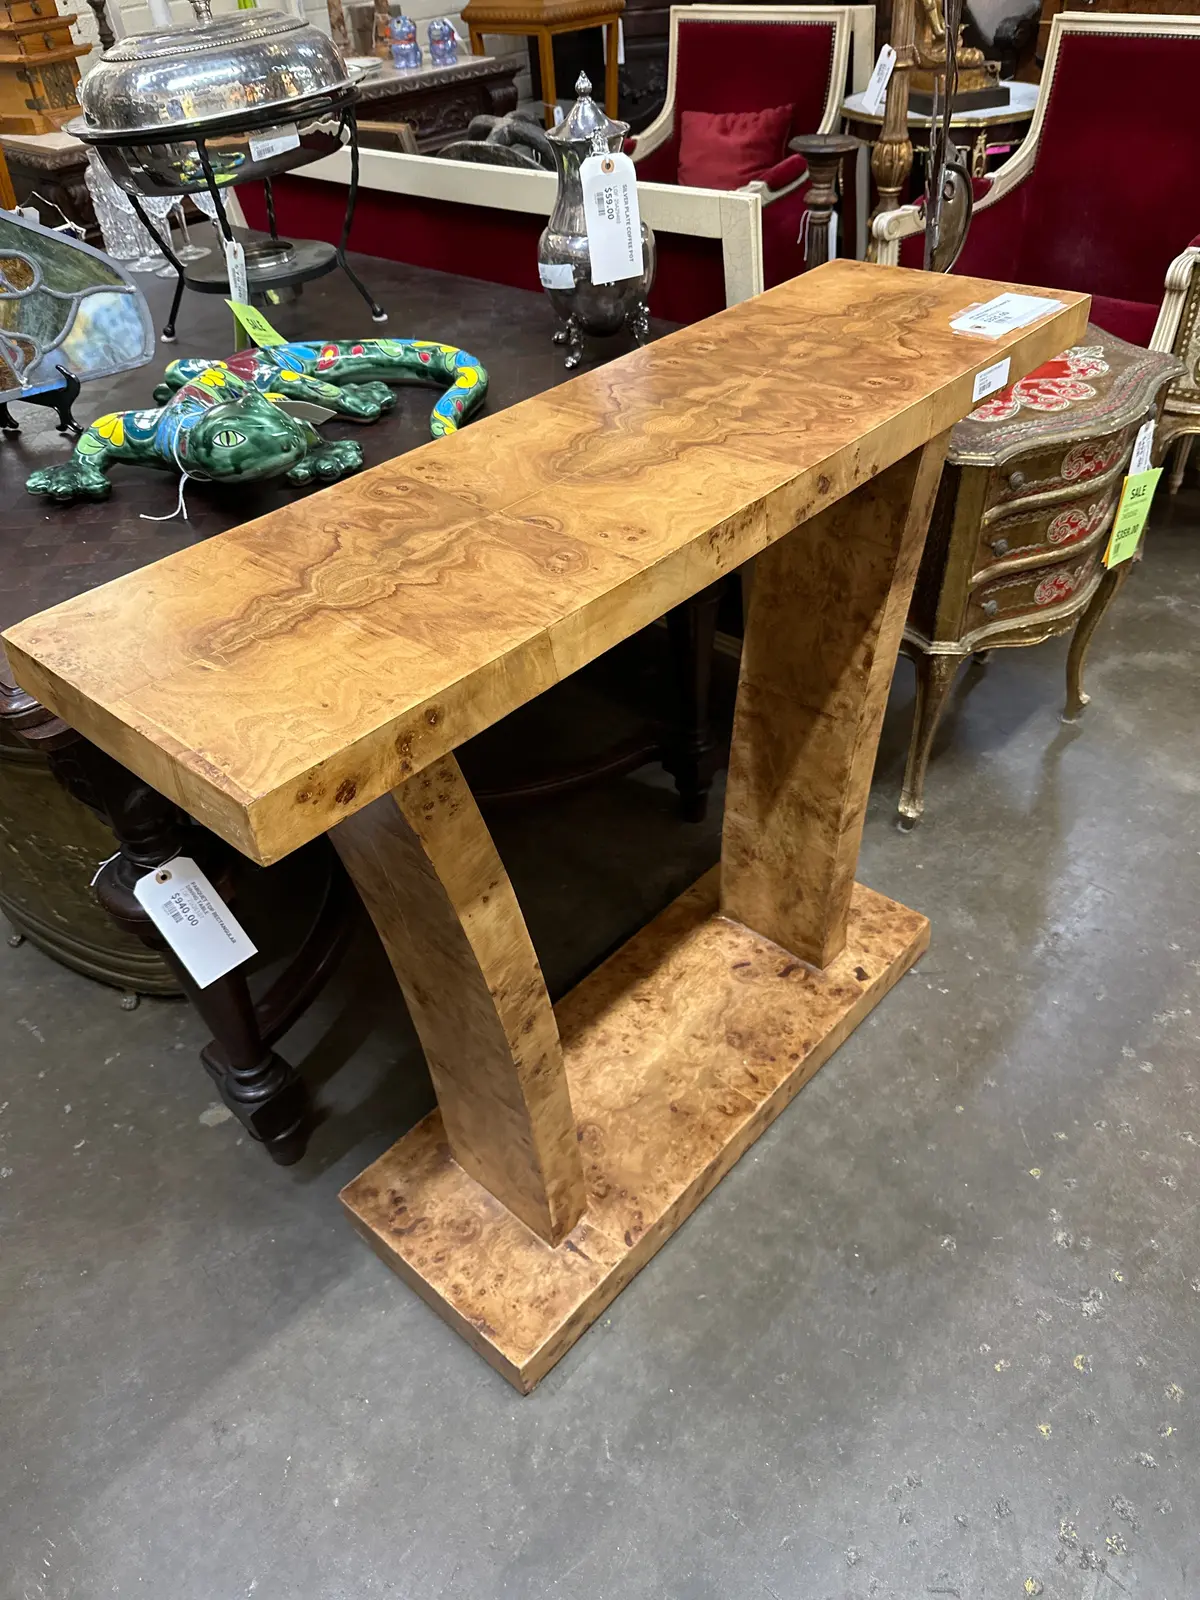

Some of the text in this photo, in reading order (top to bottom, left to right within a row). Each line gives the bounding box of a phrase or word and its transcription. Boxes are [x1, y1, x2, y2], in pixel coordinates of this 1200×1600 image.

[604, 187, 614, 220] $59.00
[1130, 484, 1147, 500] SALE
[171, 892, 199, 927] $940.00
[190, 881, 208, 902] PARQUET
[211, 911, 236, 943] RECTANGULAR
[196, 900, 209, 915] TABLE
